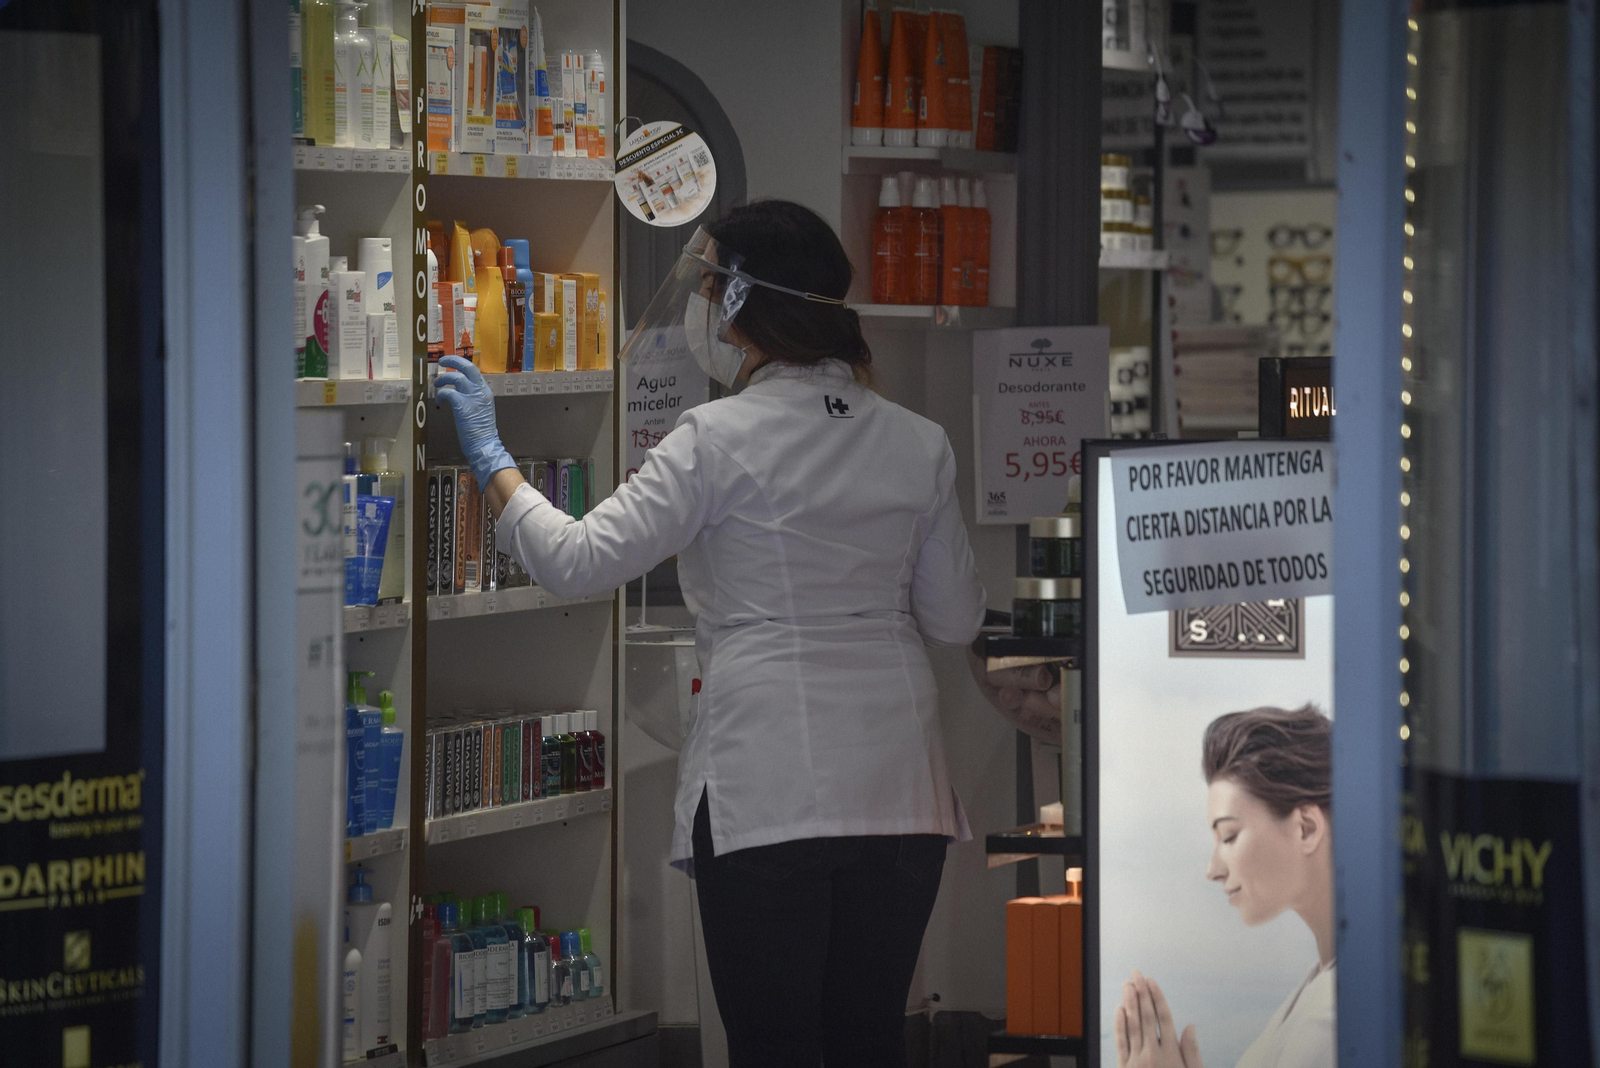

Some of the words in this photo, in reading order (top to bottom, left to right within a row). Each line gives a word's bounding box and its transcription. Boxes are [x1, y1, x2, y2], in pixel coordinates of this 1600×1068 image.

[618, 146, 651, 166] DESCUENTO
[651, 133, 676, 150] ESPECIAL
[1009, 356, 1072, 368] NUXE
[636, 376, 676, 393] Agua
[998, 382, 1086, 394] Desodorante
[628, 393, 682, 412] micelar
[644, 418, 665, 426] Antes
[1021, 410, 1064, 426] 8,95€
[1024, 436, 1066, 447] AHORA
[1005, 452, 1082, 482] 5,95€
[1129, 464, 1163, 491] POR
[1168, 458, 1220, 486] FAVOR
[1225, 450, 1324, 481] MANTENGA
[988, 492, 1006, 502] 365
[443, 483, 451, 558] MARVIS
[1127, 511, 1181, 542] CIERTA
[1185, 503, 1270, 536] DISTANCIA
[1275, 498, 1308, 526] POR
[1312, 495, 1332, 522] LA
[1143, 562, 1240, 597] SEGURIDAD
[1244, 559, 1266, 585] DE
[1268, 553, 1328, 584] TODOS
[1439, 830, 1554, 890] VICHY
[0, 850, 146, 898] DARPHIN
